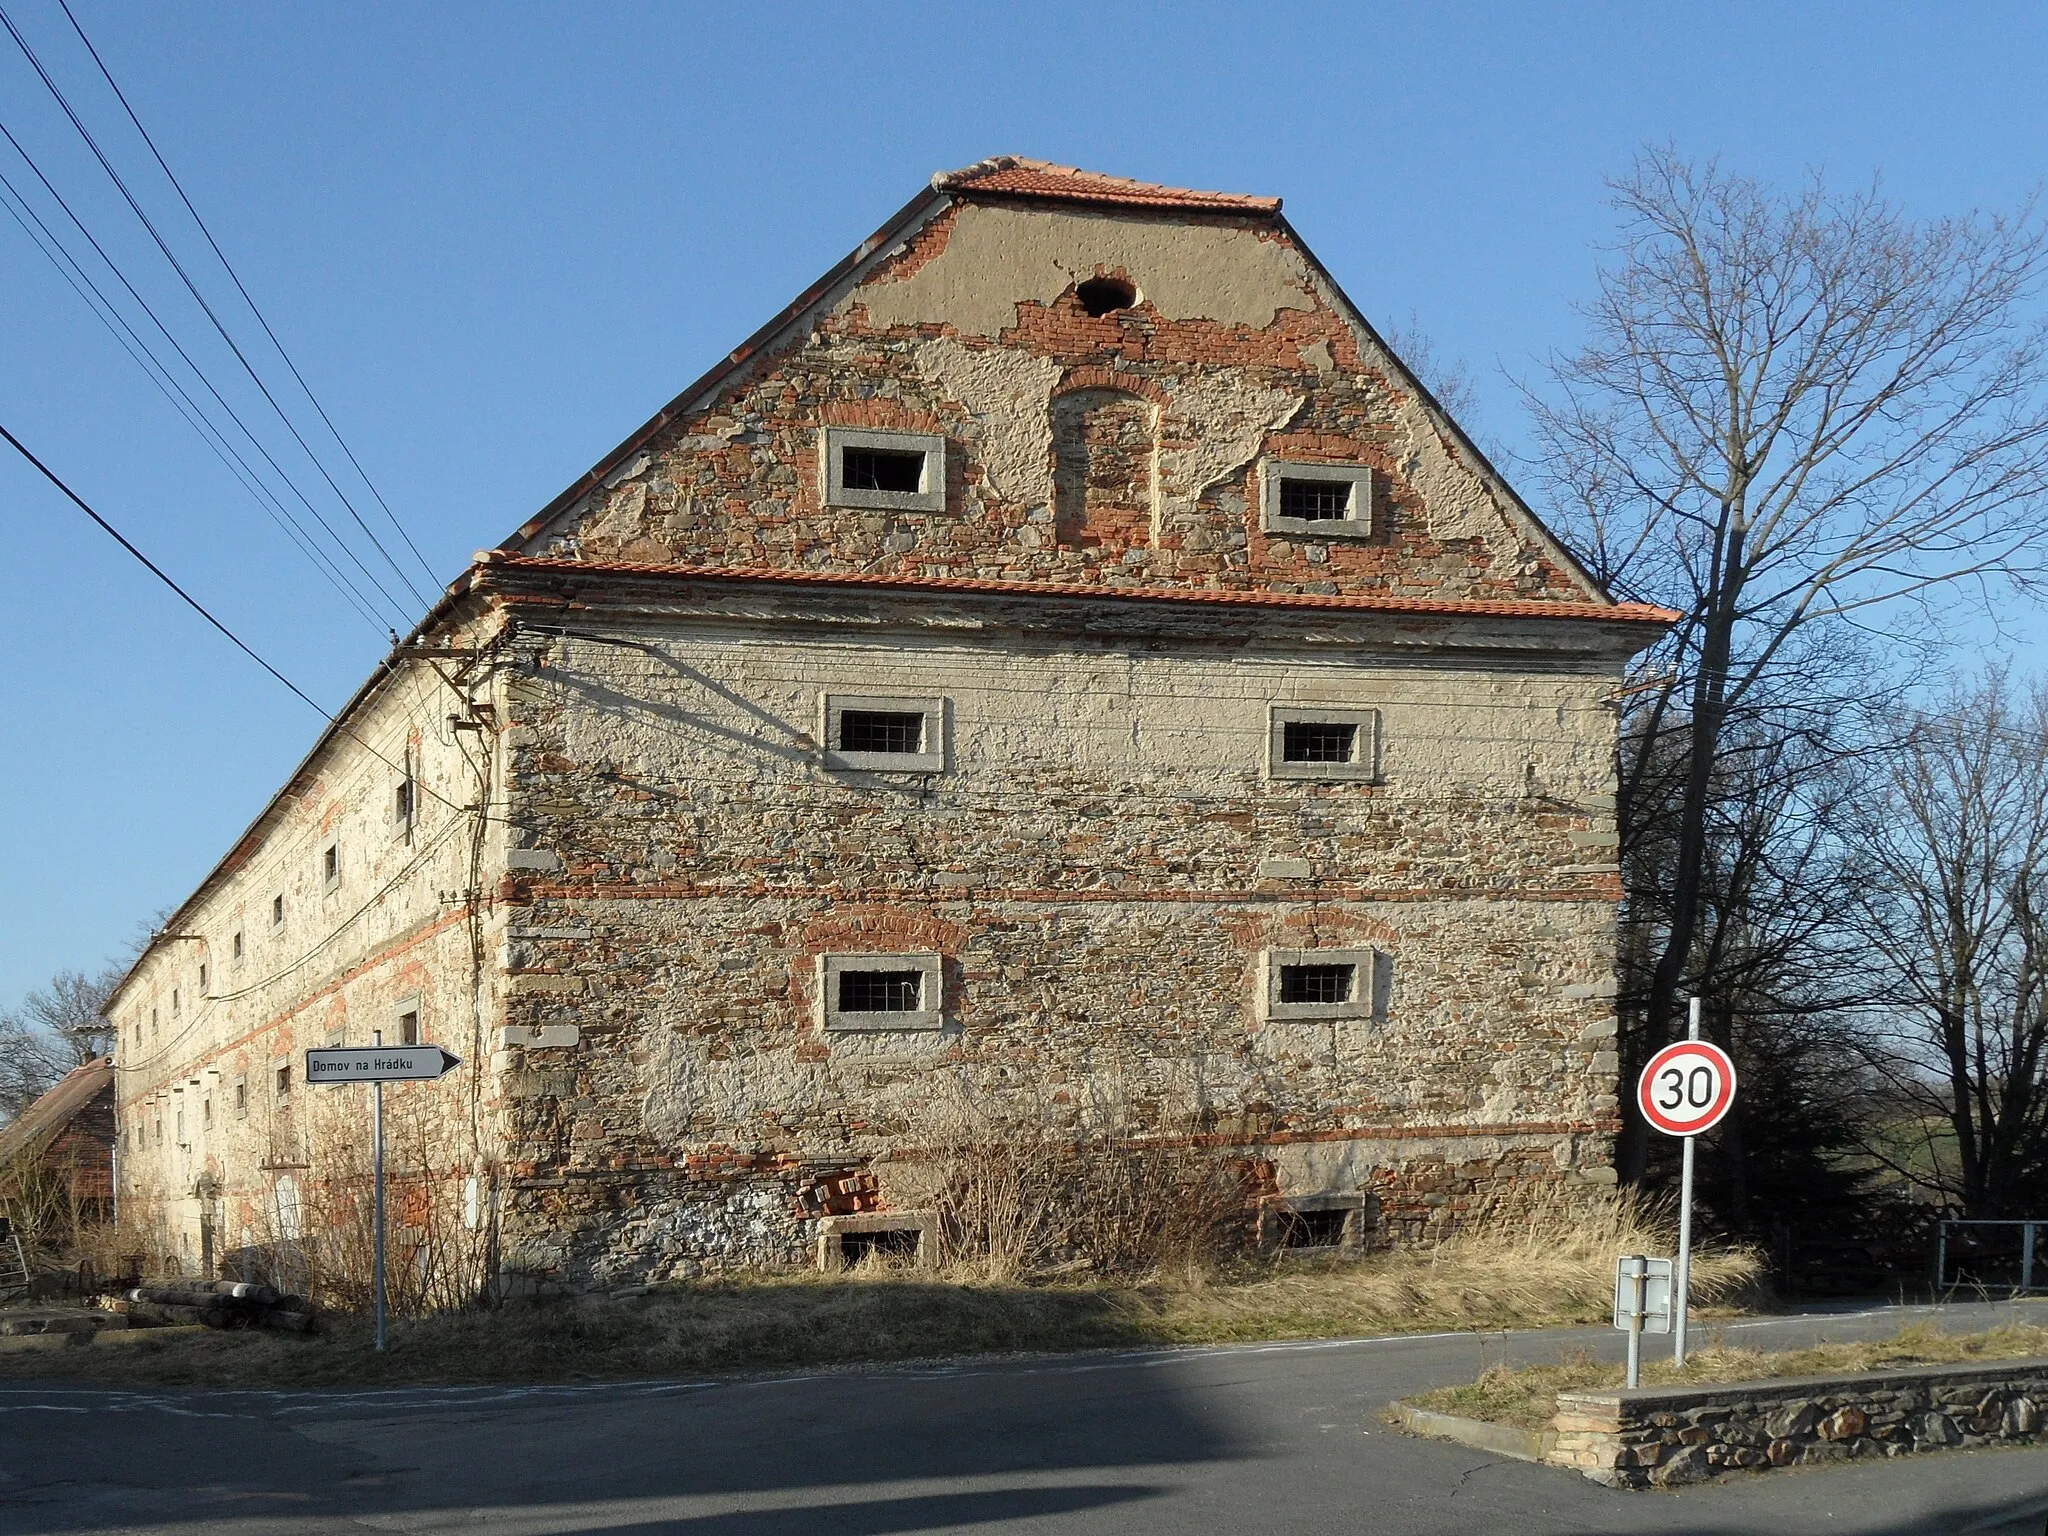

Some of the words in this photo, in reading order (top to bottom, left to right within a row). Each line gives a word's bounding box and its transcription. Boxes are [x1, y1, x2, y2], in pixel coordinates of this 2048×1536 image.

[313, 1060, 350, 1072] Domov
[356, 1061, 369, 1070] na
[374, 1058, 413, 1070] Hrádku
[1659, 1066, 1712, 1109] 30
